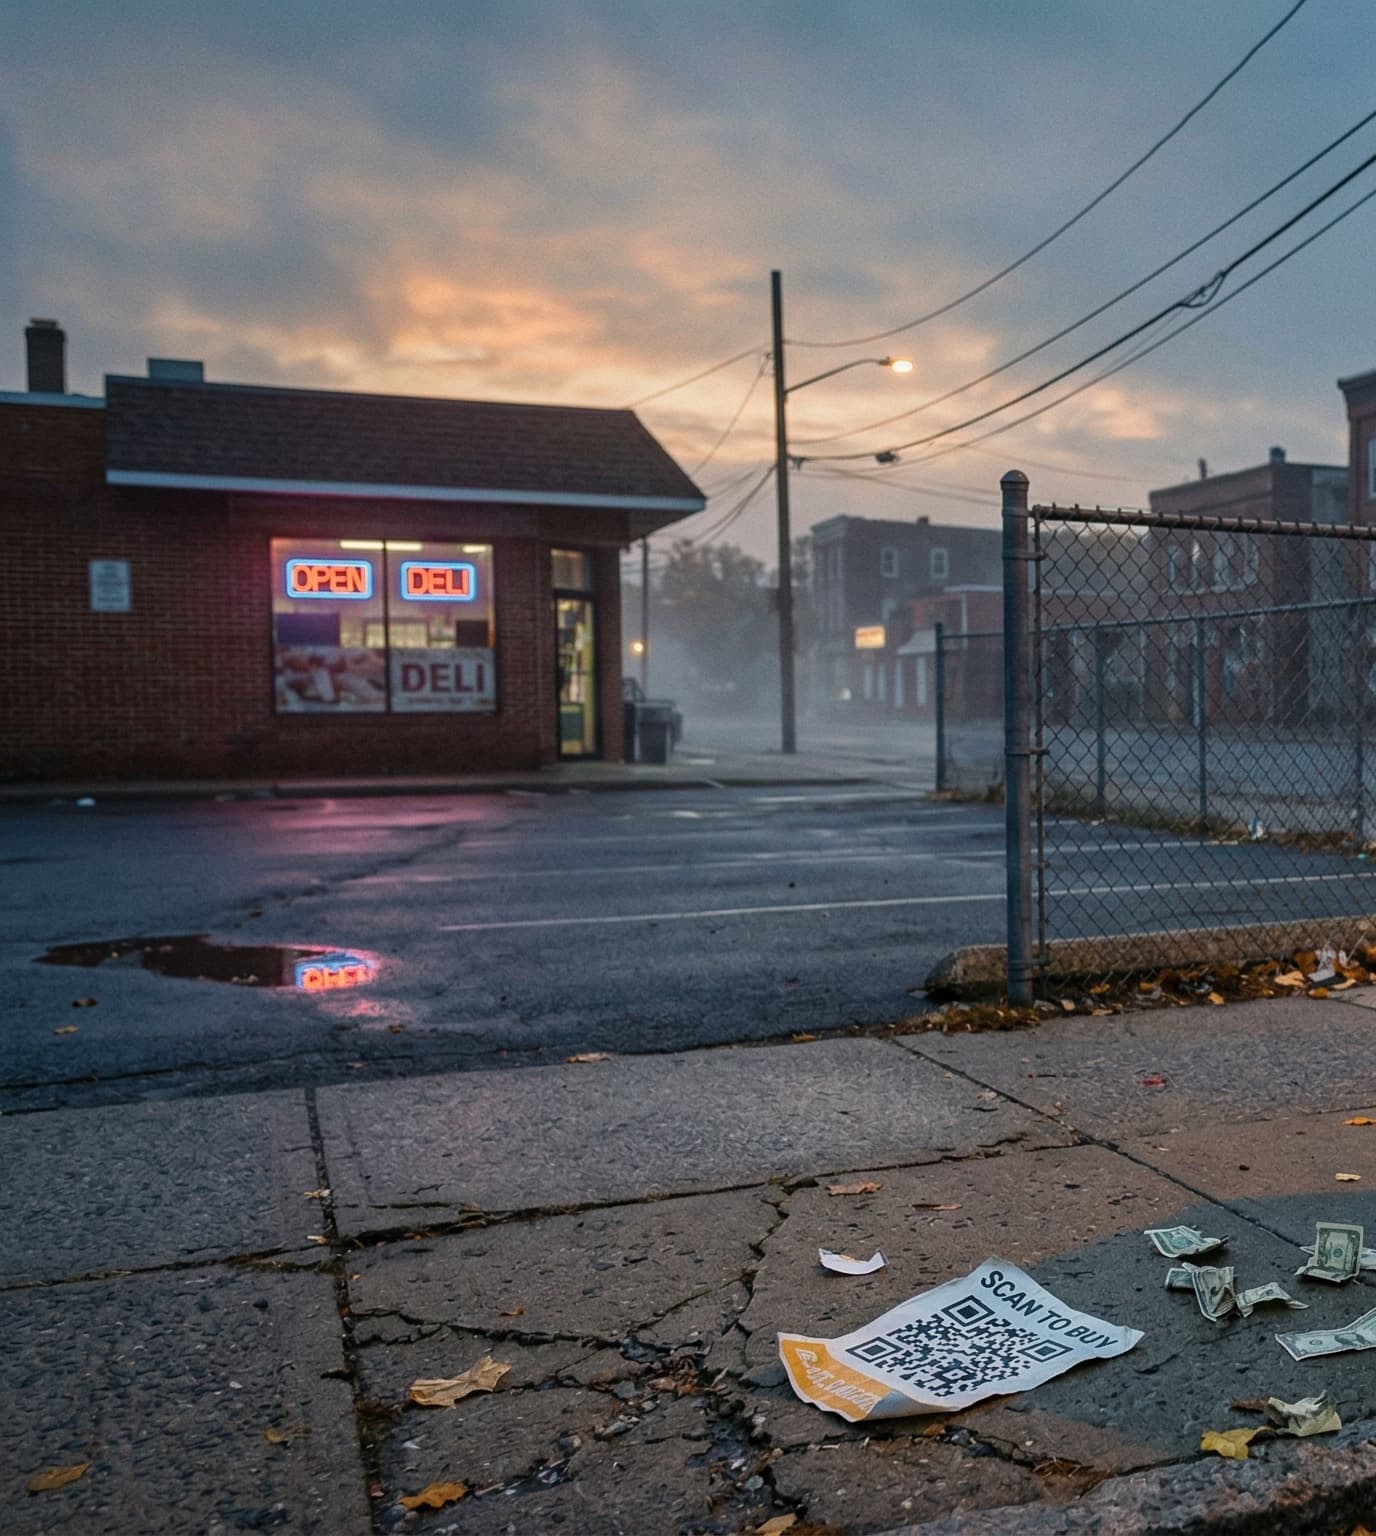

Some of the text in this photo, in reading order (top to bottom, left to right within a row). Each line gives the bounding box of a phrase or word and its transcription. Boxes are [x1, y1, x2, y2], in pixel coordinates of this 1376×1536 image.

[293, 565, 366, 593] OPEN
[407, 567, 469, 595] DELI
[402, 663, 484, 693] DELI
[981, 1270, 1119, 1348] SCAN TO BUY
